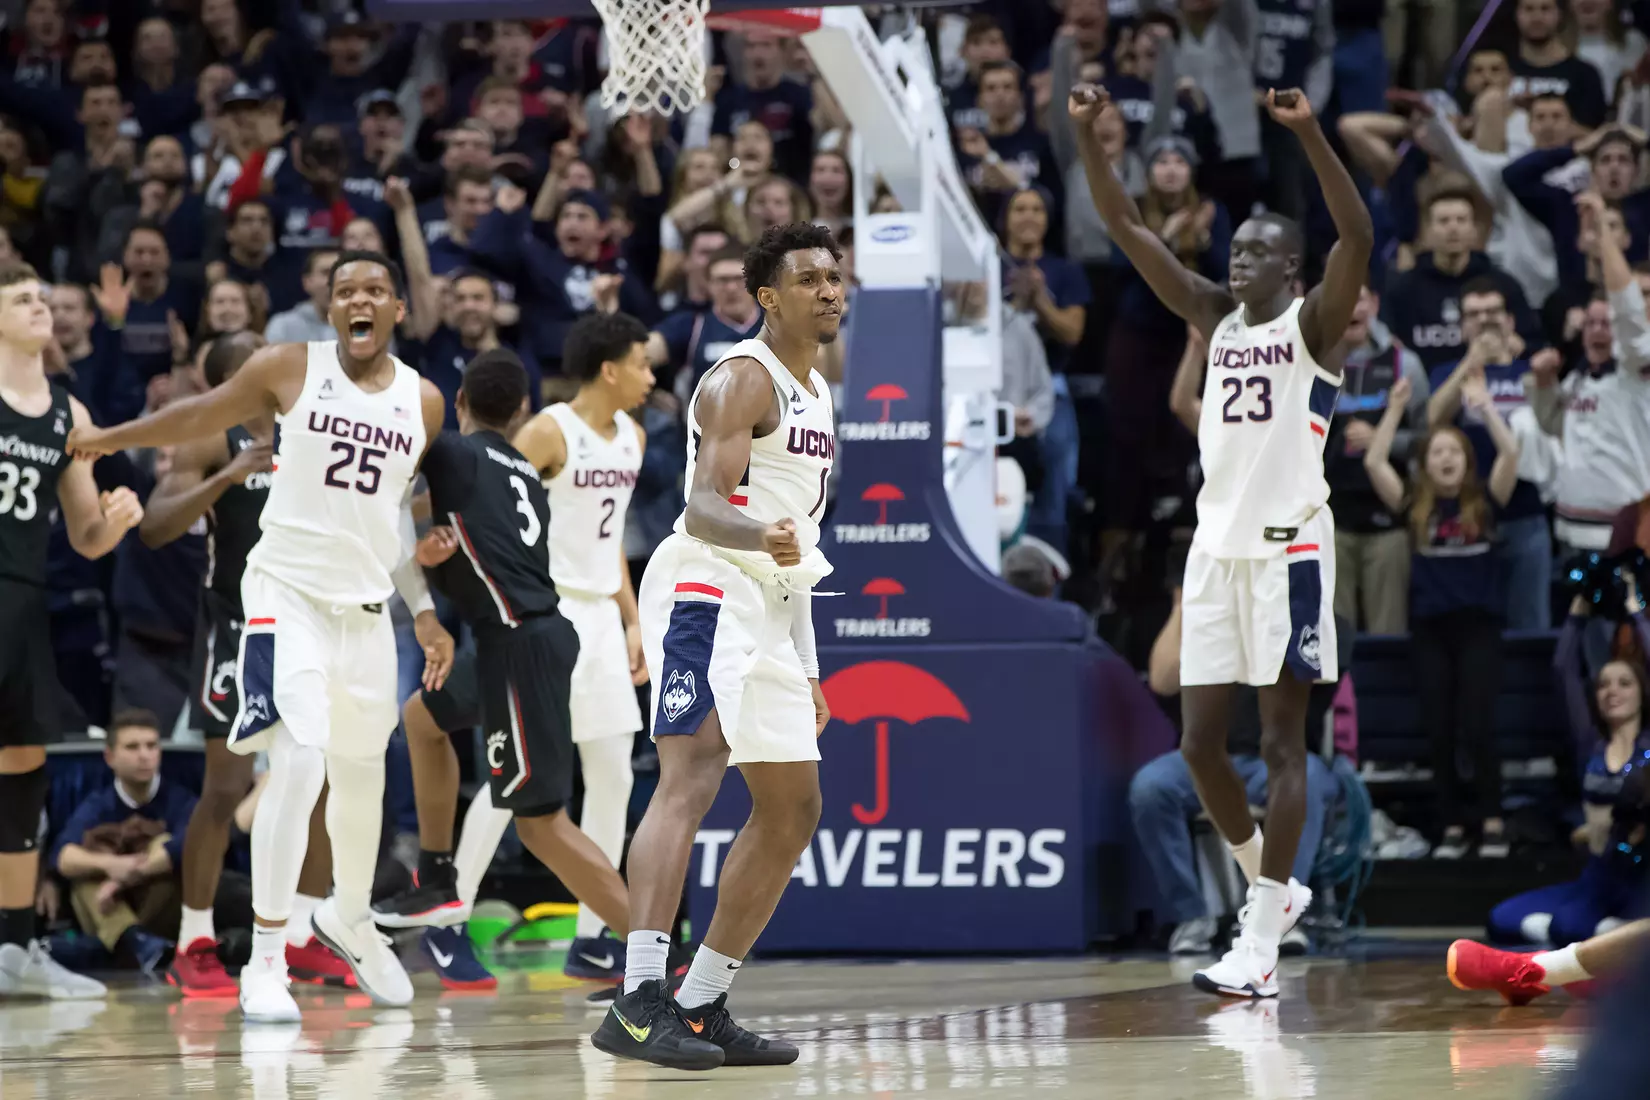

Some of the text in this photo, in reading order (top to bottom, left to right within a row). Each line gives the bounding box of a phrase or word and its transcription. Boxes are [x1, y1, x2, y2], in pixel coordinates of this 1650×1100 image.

[1213, 342, 1293, 369] UCONN
[1412, 325, 1461, 347] UCO
[1222, 376, 1272, 423] 23
[308, 411, 412, 456] UCONN
[787, 426, 834, 461] UCON
[838, 421, 931, 440] TRAVELERS
[324, 440, 387, 495] 25
[0, 461, 40, 520] 33
[509, 475, 541, 547] 3
[807, 467, 829, 518] 1
[599, 498, 615, 539] 2
[833, 523, 930, 543] TRAVELERS
[834, 618, 931, 637] TRAVELERS
[694, 829, 1066, 887] TAVELERS
